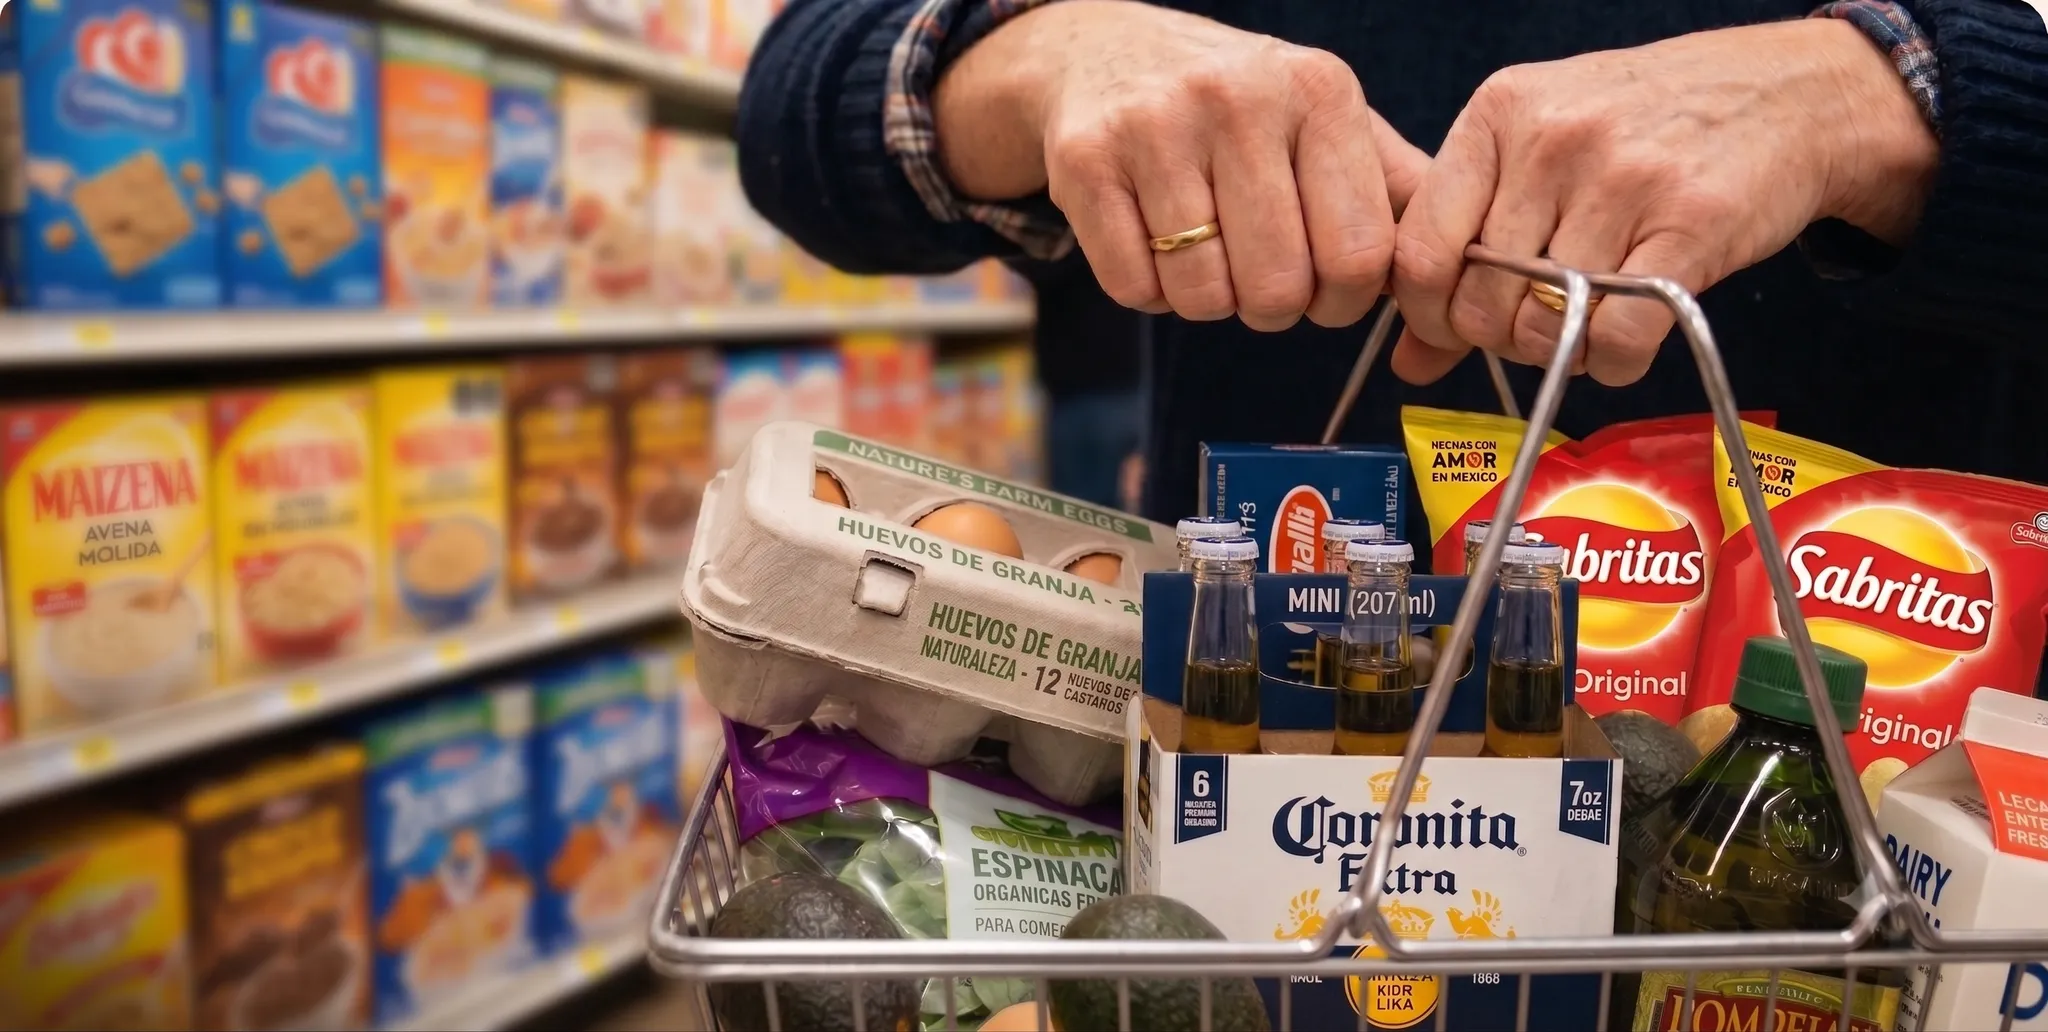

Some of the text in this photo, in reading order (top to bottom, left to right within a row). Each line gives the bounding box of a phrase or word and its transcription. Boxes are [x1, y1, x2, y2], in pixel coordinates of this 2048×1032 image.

[1431, 441, 1497, 450] NECNAS CON
[1432, 451, 1497, 468] AMOR
[1774, 455, 1796, 467] CON
[848, 441, 1128, 535] NATURE'S FARM EGGS
[1432, 472, 1497, 482] EN MEXICO
[31, 457, 198, 524] MAIZENA
[85, 520, 154, 544] AVENA
[78, 540, 162, 566] MOLIDA
[838, 516, 943, 560] HUEVOS
[952, 548, 984, 572] DE
[992, 560, 1096, 605] GRANJA
[1288, 587, 1340, 613] MINI
[1790, 545, 1994, 634] Sabritas
[928, 602, 1142, 684] HUEVOS DE GRANJA
[920, 634, 1017, 682] NATURALEZA
[1034, 666, 1062, 696] 12
[1067, 672, 1111, 695] NUEVOS
[1575, 668, 1687, 701] Original
[1193, 770, 1210, 797] 6
[1569, 781, 1602, 806] 7oz
[1567, 808, 1602, 821] DEBAE
[971, 848, 1122, 897] ESPINACA
[973, 883, 1072, 908] ORGANICAS
[975, 917, 1015, 934] PARA
[1377, 985, 1413, 997] KIDR
[1472, 973, 1500, 984] 1868
[1376, 998, 1414, 1011] LIKA
